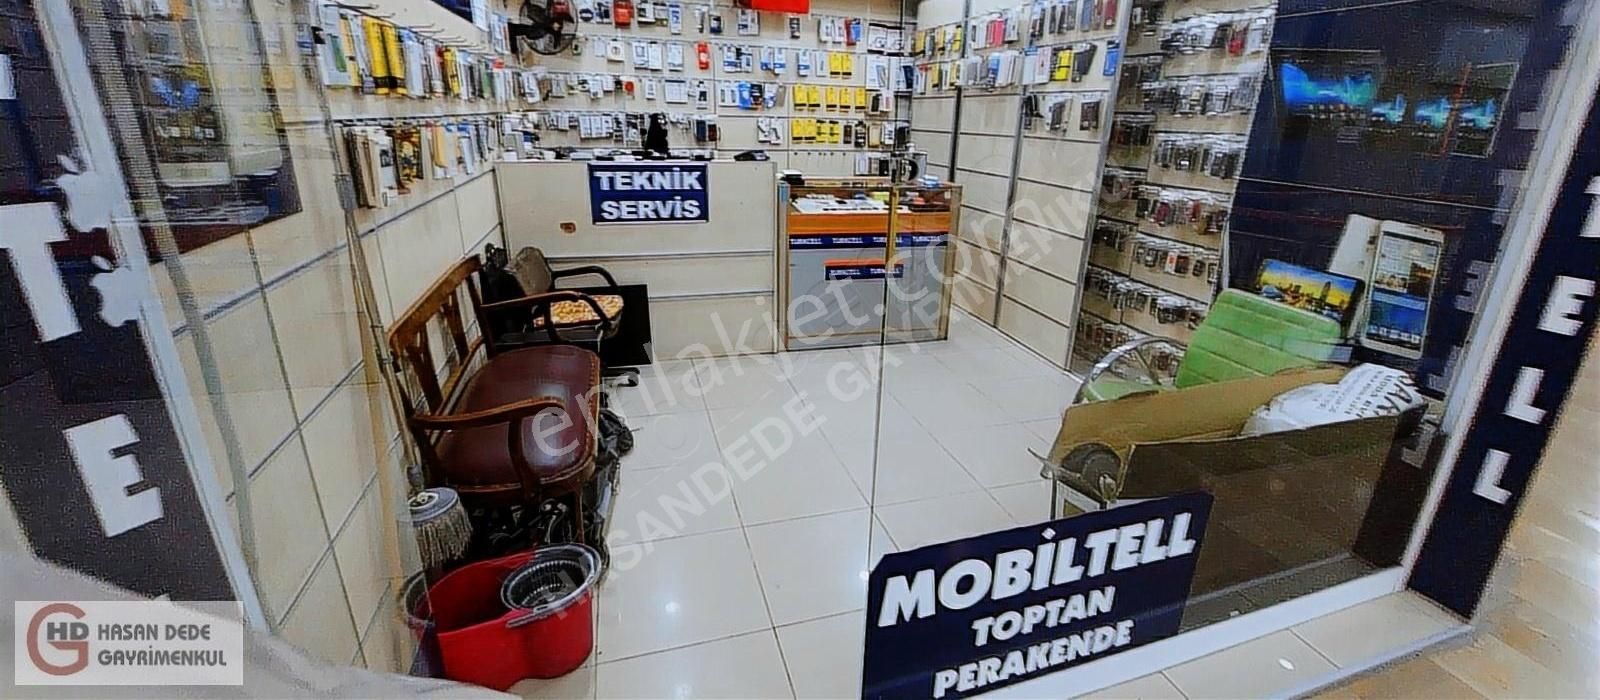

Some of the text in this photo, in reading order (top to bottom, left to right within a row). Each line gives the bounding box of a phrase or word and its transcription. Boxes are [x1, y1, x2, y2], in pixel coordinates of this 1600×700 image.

[594, 168, 703, 191] TEKNİK
[600, 196, 701, 220] SERVİS
[877, 511, 1197, 628] MOBİLTELL
[971, 585, 1116, 647] TOPTAN
[932, 619, 1135, 699] PERAKENDE
